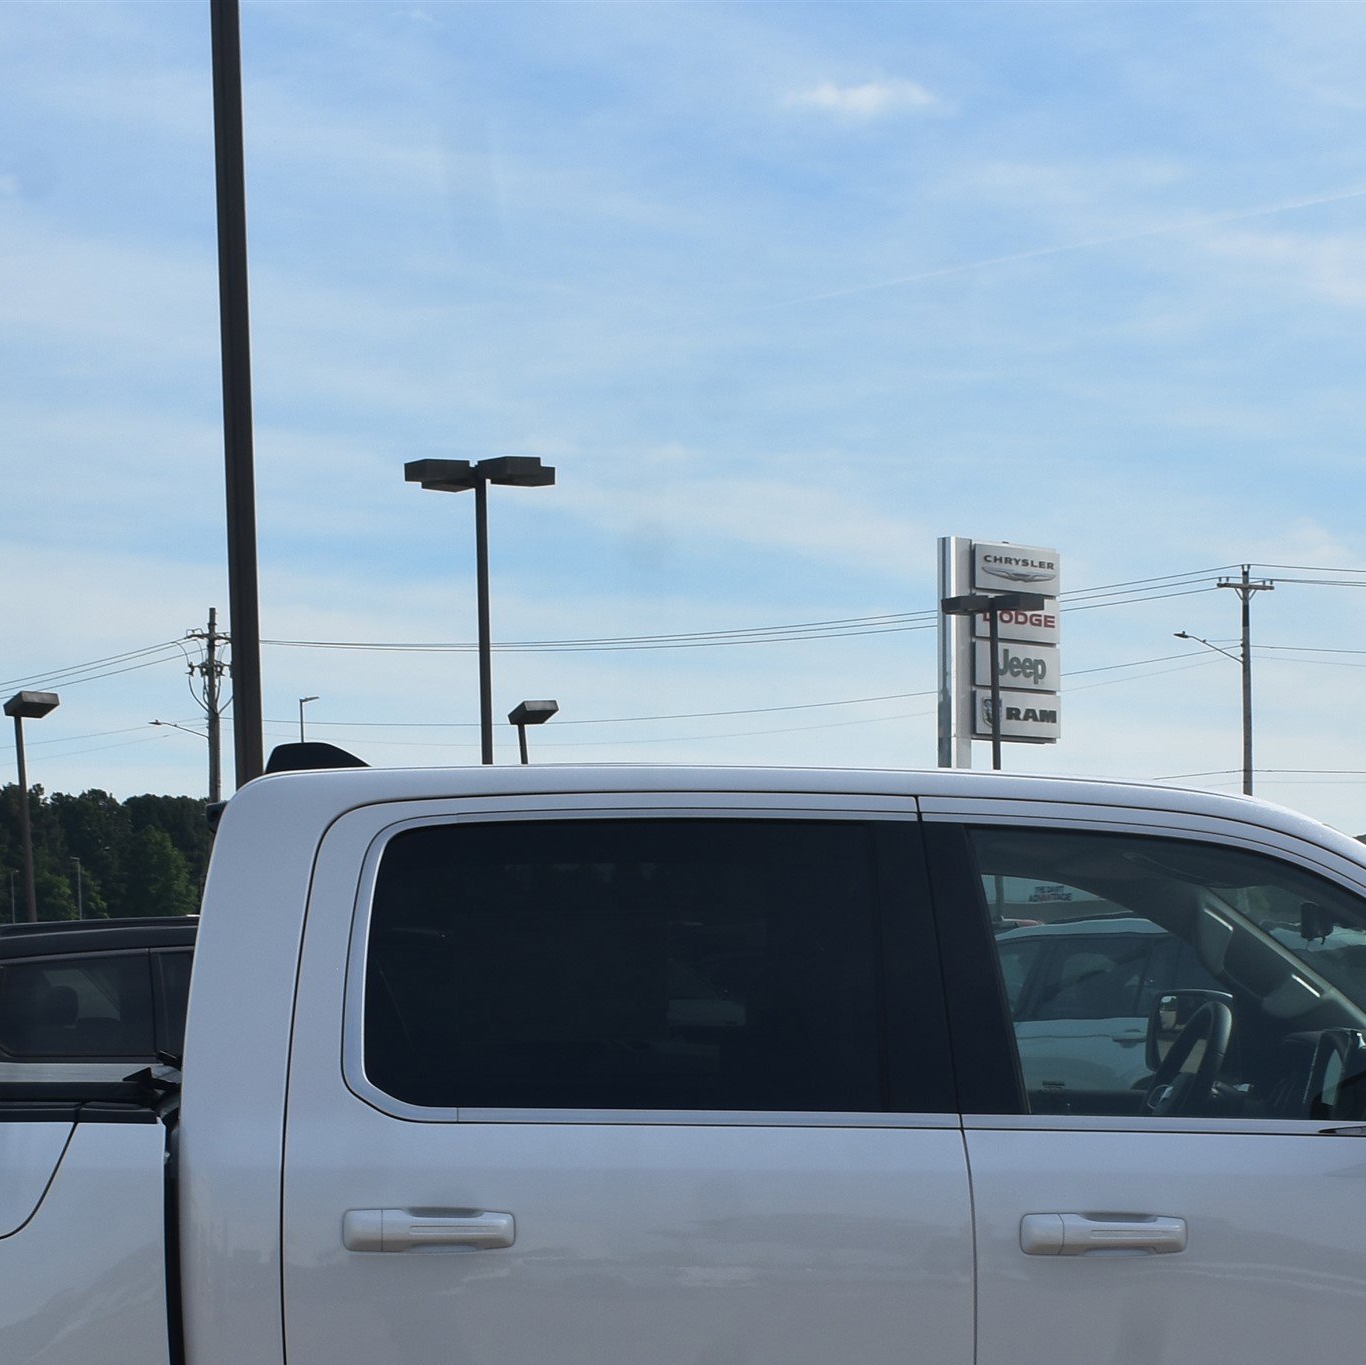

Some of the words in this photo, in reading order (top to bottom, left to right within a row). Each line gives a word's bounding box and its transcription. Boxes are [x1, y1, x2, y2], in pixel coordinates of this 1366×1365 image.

[983, 554, 1055, 571] CHRYSLER
[998, 649, 1047, 684] Jeep
[1006, 706, 1057, 724] RAM
